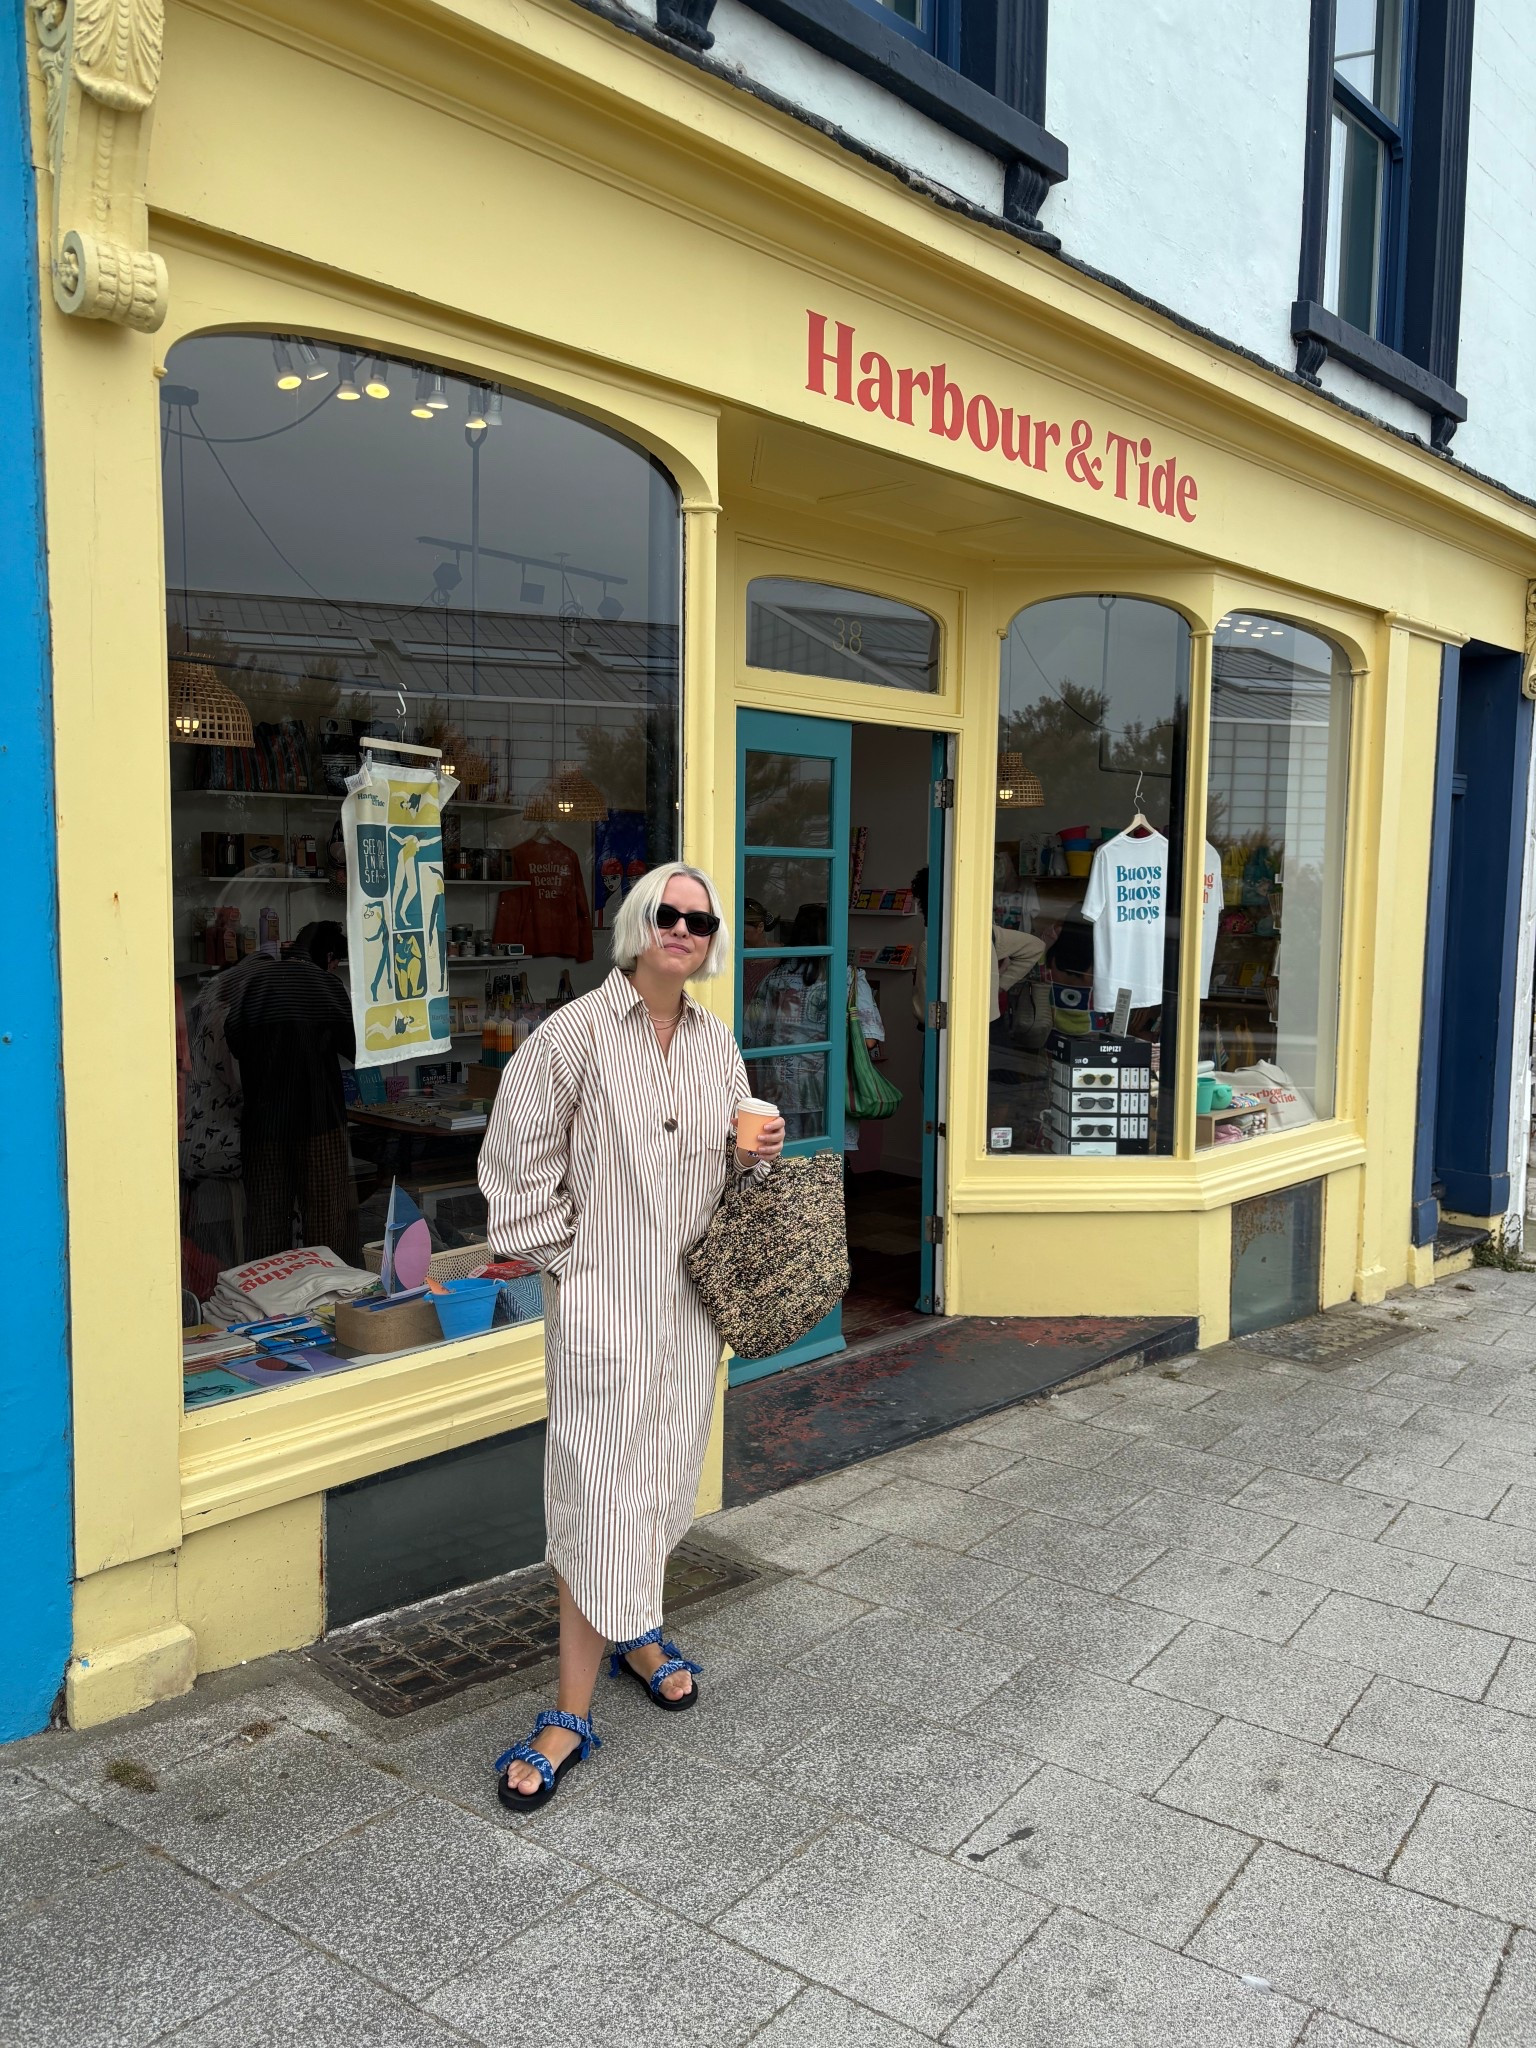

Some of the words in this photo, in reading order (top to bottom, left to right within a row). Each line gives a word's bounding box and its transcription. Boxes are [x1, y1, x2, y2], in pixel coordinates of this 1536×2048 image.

[804, 308, 1061, 472] Harbour
[1105, 430, 1199, 523] Tide
[832, 617, 863, 655] 38
[363, 838, 376, 855] SEE
[528, 862, 569, 876] Resting
[1116, 865, 1162, 884] Buoys
[538, 888, 557, 899] Fae
[1116, 885, 1161, 905] Buoys
[1117, 905, 1160, 925] Buoys
[1099, 1045, 1122, 1053] IZIPIZI
[1239, 1087, 1284, 1099] rbour
[238, 1258, 335, 1293] Resting
